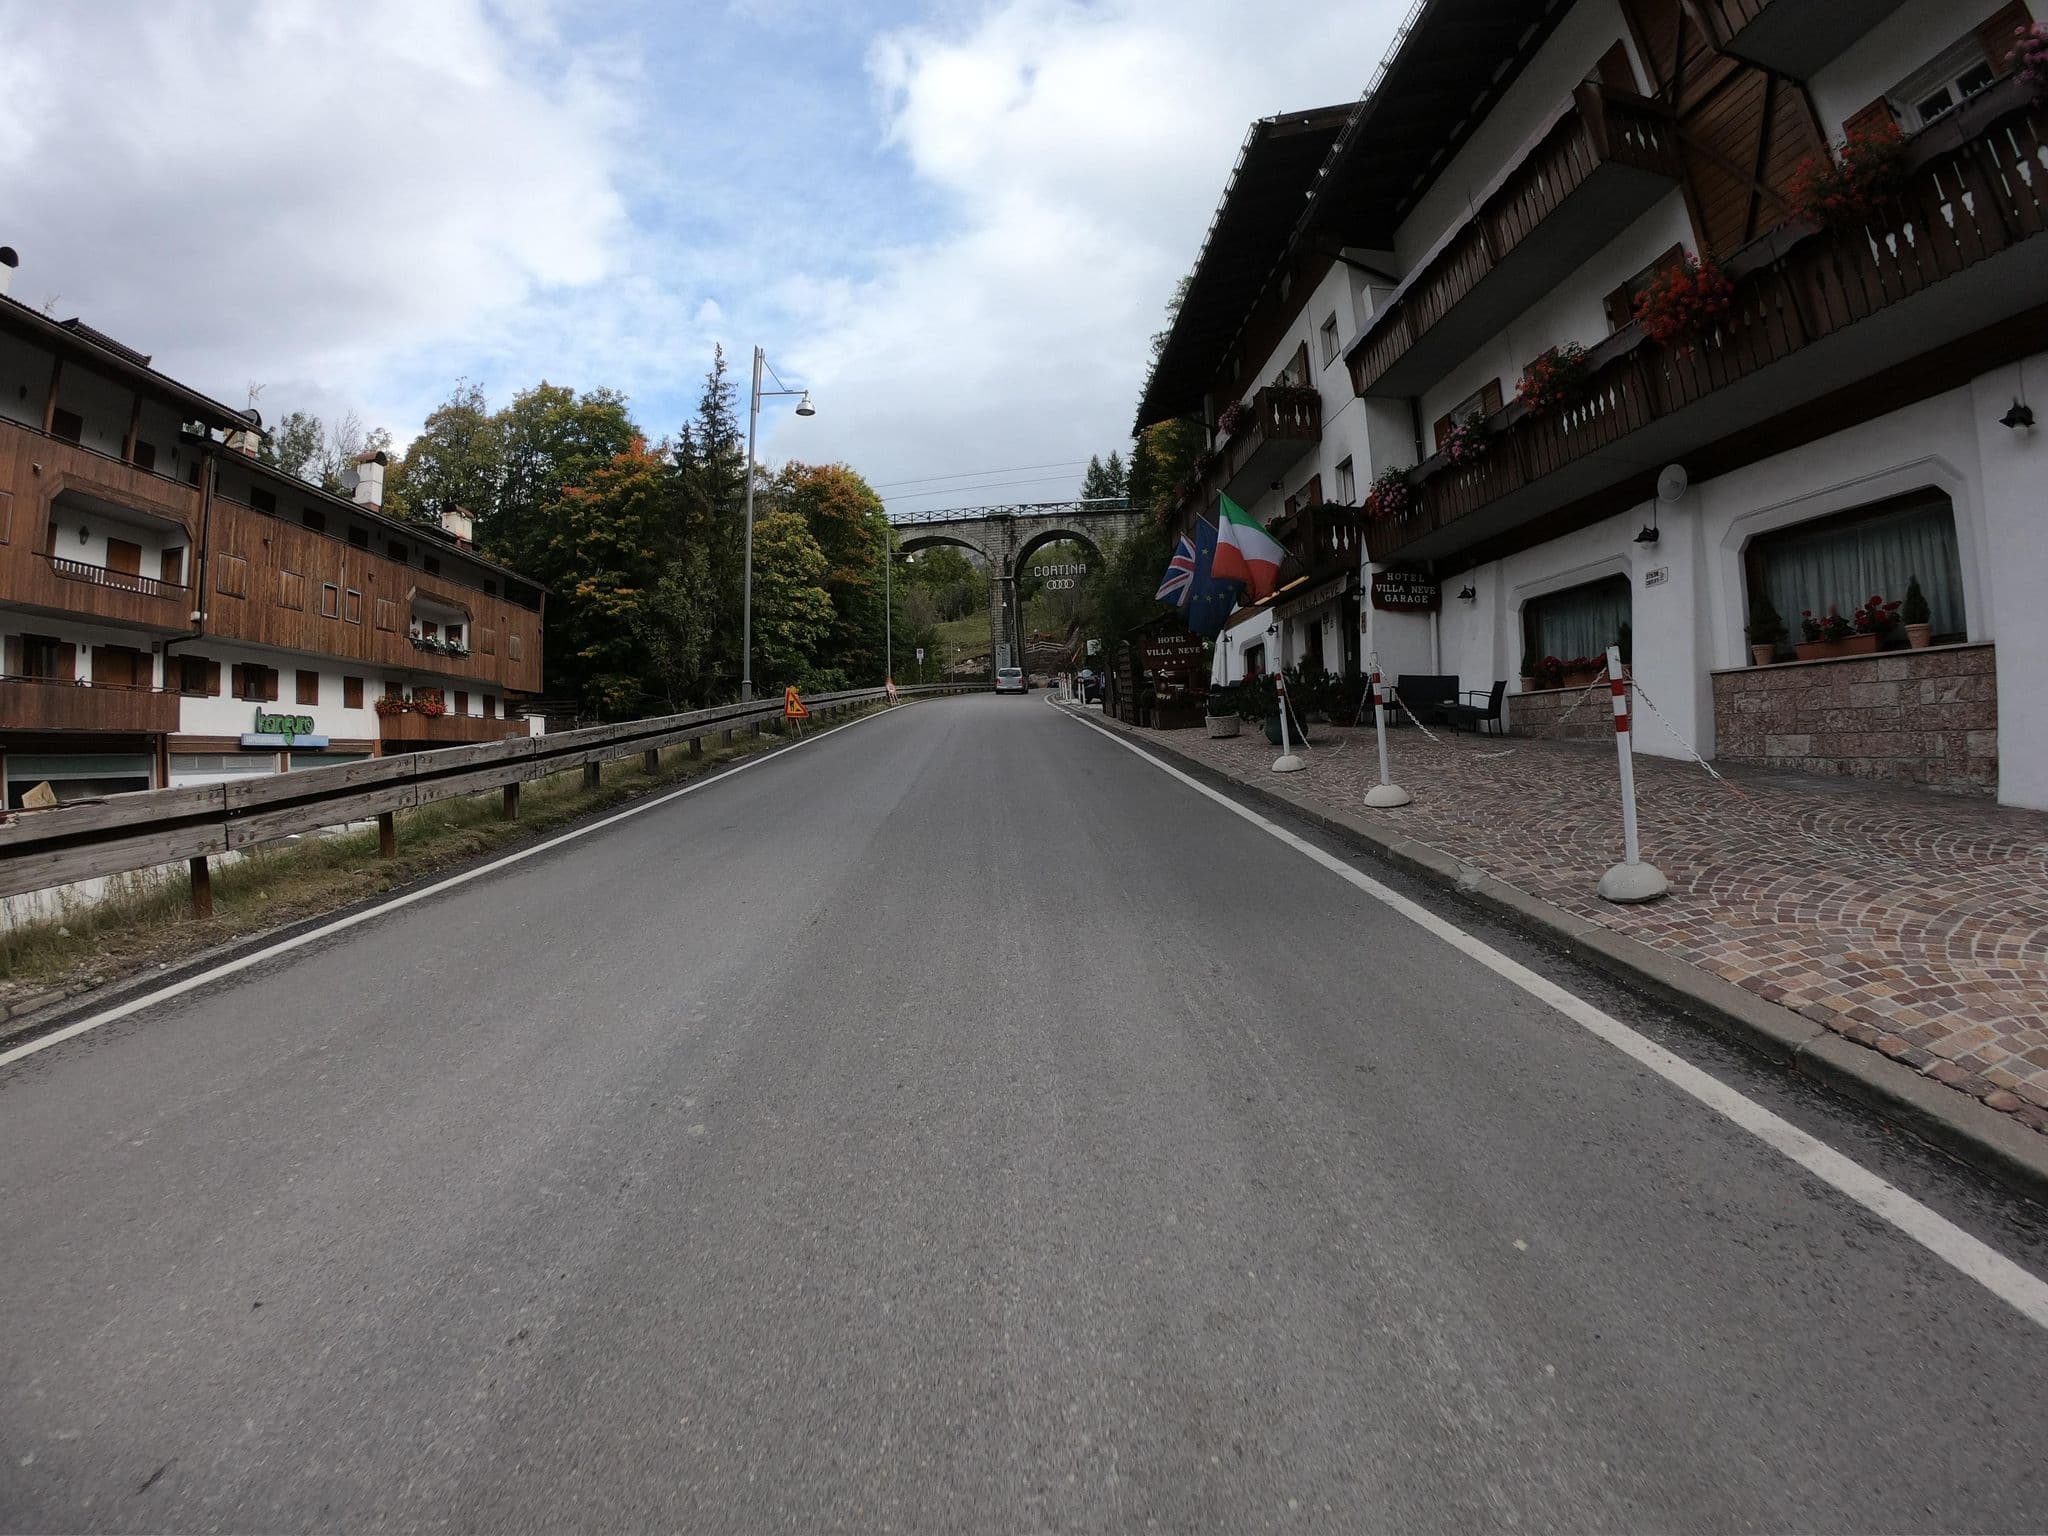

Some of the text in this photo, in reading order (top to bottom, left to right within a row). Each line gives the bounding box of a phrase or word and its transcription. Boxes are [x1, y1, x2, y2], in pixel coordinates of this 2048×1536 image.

[1034, 563, 1087, 577] CORTINA
[1387, 572, 1425, 583] HOTEL
[1376, 583, 1436, 595] VILLA NEVE
[1384, 594, 1428, 604] GARAGE
[1157, 636, 1186, 644] HOTEL
[1146, 646, 1201, 657] VILLA NEVE
[255, 705, 315, 745] kanguro
